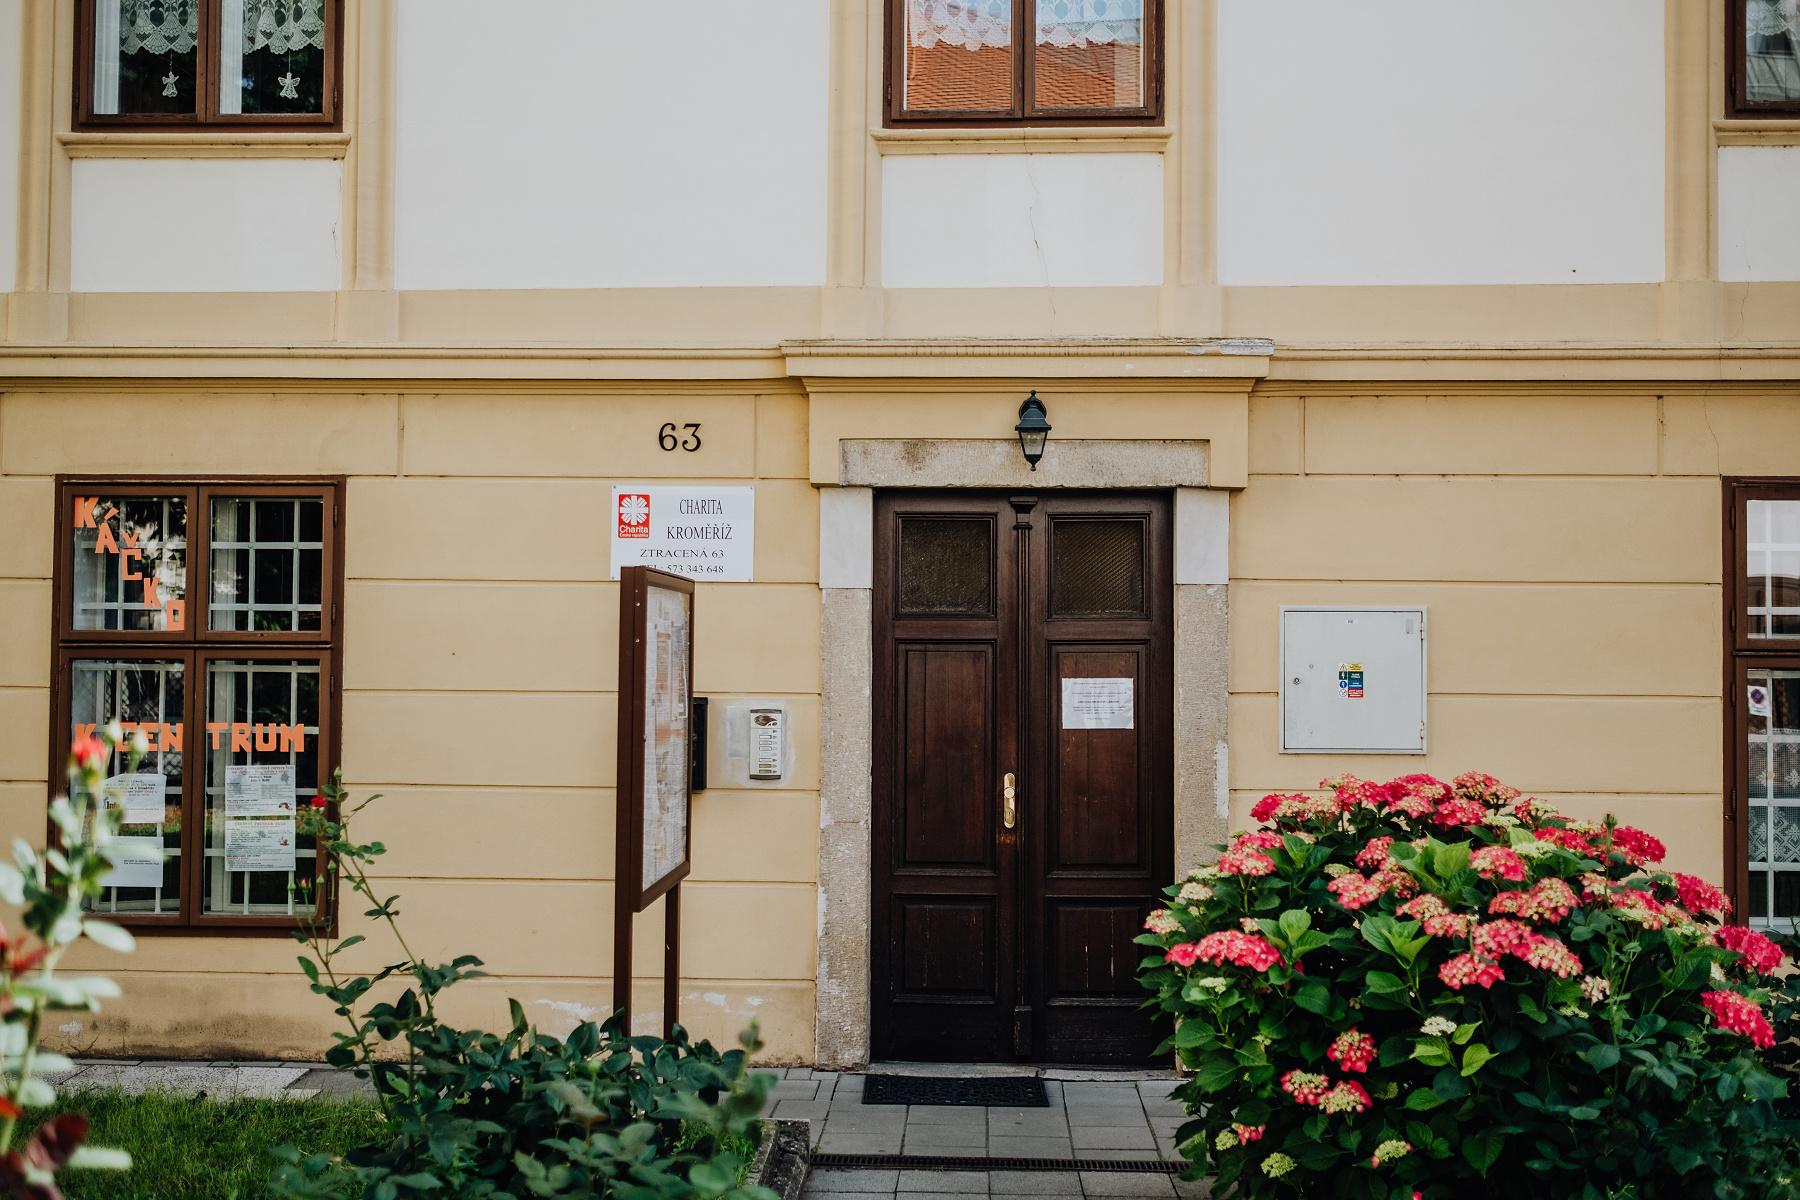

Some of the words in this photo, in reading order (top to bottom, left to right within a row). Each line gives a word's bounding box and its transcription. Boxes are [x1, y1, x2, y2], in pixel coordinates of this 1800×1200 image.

[658, 422, 702, 452] 63
[679, 499, 723, 515] CHARITA
[619, 525, 649, 534] Charita
[667, 522, 733, 540] KROMĚŘÍŽ
[640, 548, 708, 558] ZTRACENÁ
[711, 549, 725, 559] 63
[686, 564, 704, 574] 343
[706, 564, 724, 574] 648
